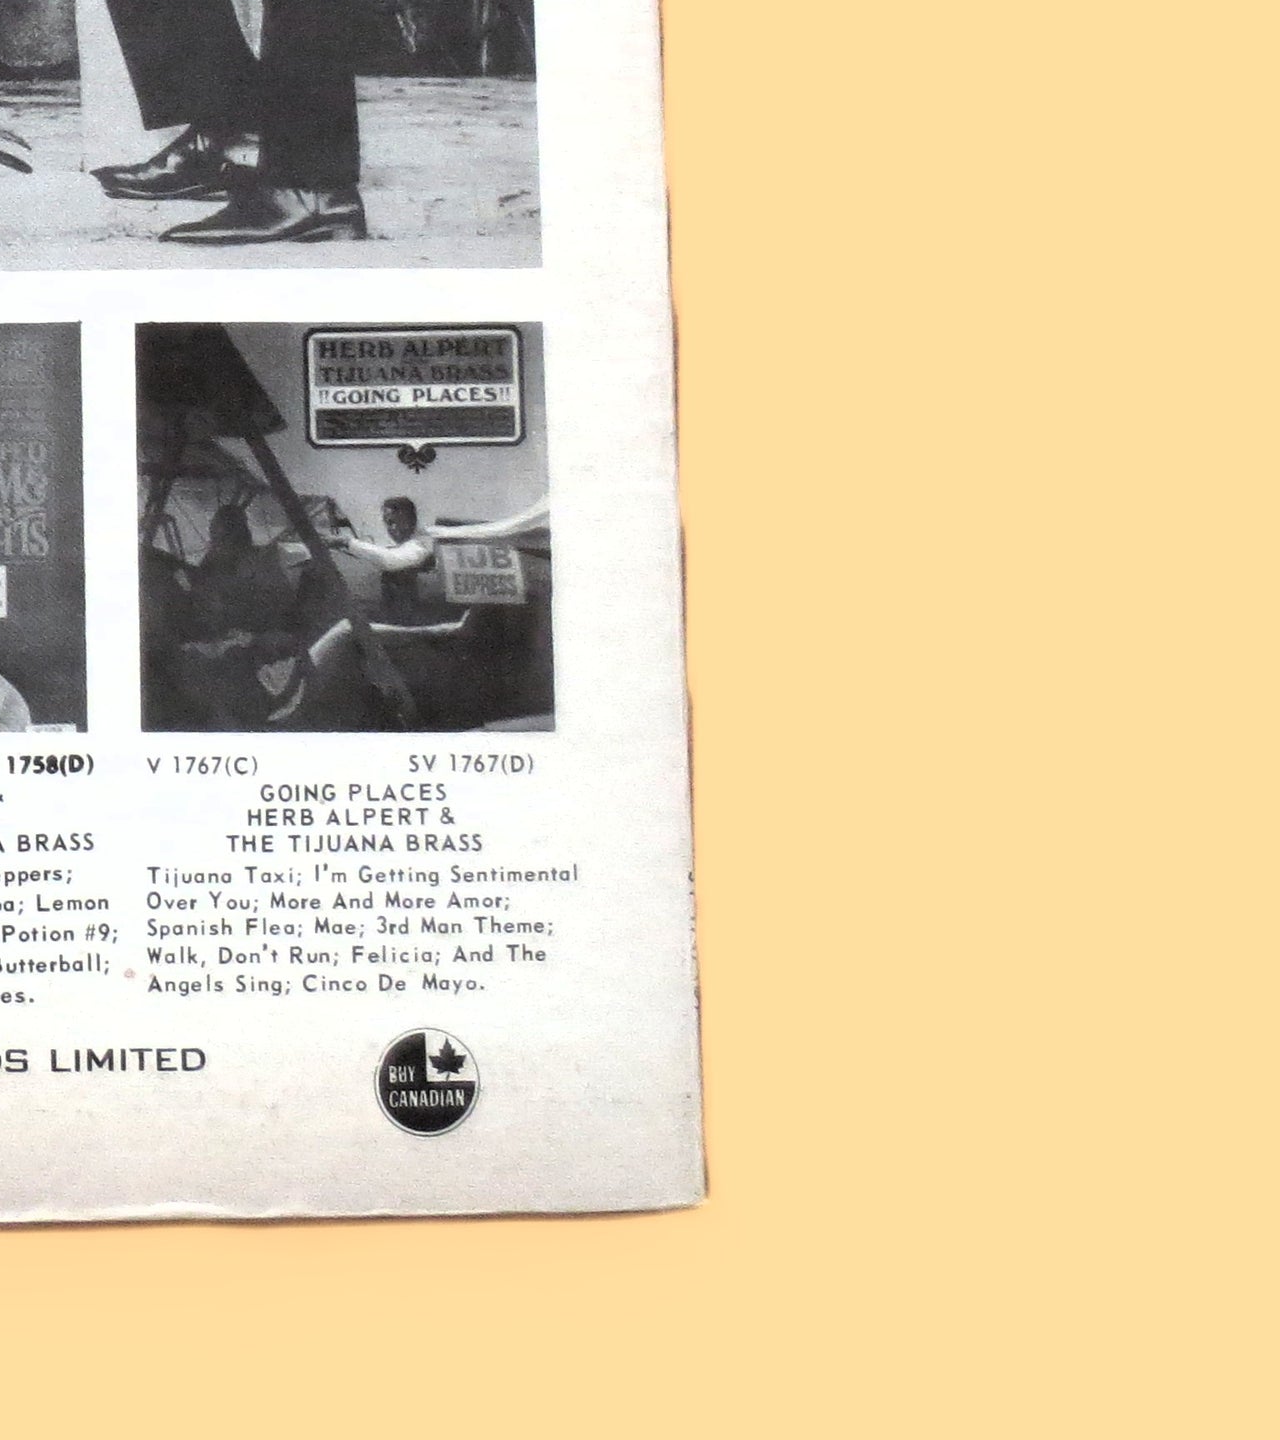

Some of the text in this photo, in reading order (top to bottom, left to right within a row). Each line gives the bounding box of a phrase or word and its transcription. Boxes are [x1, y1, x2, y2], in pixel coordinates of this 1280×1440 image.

[7, 754, 94, 777] 1758(D)
[147, 756, 257, 776] V 1767(C)
[409, 754, 533, 775] SV 1767(D)
[260, 783, 446, 804] GOING PLACES
[248, 807, 455, 826] HERB ALPERT &
[18, 833, 94, 852] BRASS
[226, 834, 482, 853] THE TIJUANA BRASS
[147, 863, 577, 888] Tijuana Taxi; I'm Getting Sentimental
[51, 1048, 206, 1072] LIMITED
[388, 1089, 466, 1108] CANADIAN
